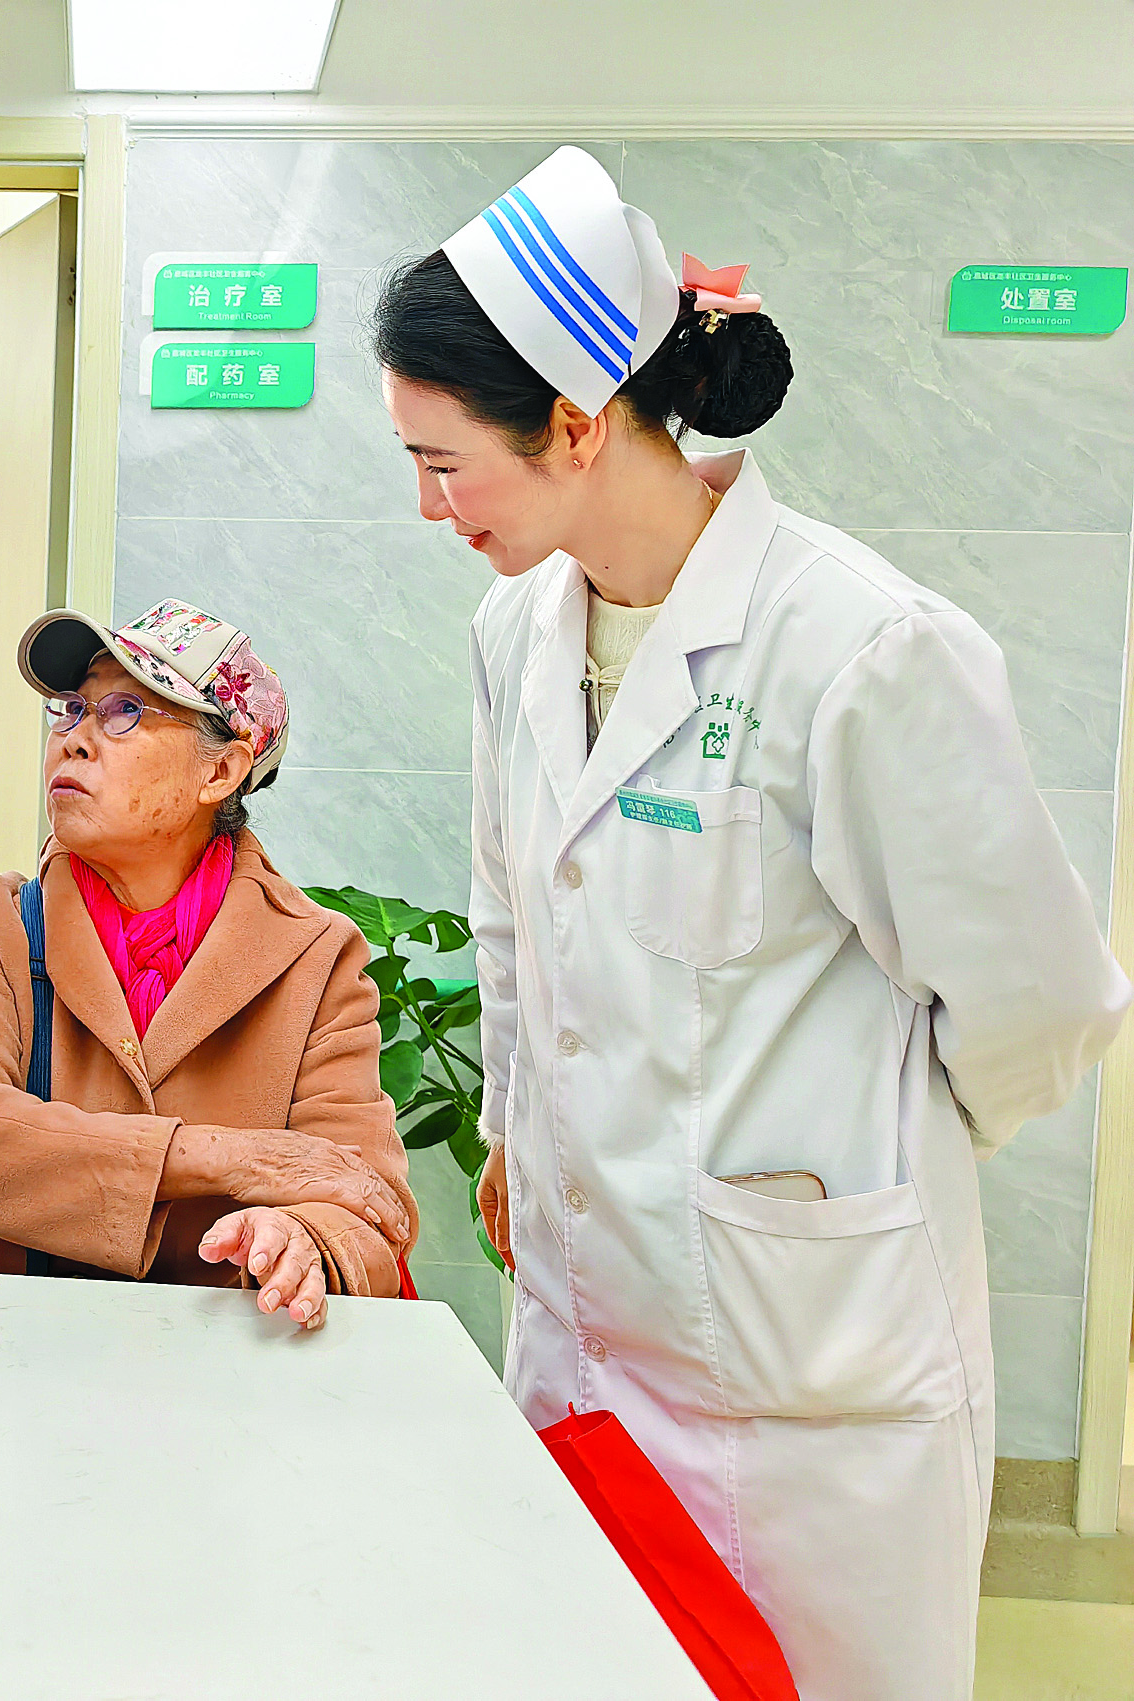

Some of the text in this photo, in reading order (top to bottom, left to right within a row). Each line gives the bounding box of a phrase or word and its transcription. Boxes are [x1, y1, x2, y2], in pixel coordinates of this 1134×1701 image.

[188, 284, 283, 307] 治疗室
[1000, 287, 1077, 311] 处置室
[199, 313, 272, 321] Treatment Room
[186, 364, 280, 386] 配药室
[209, 391, 254, 401] Pharmacy
